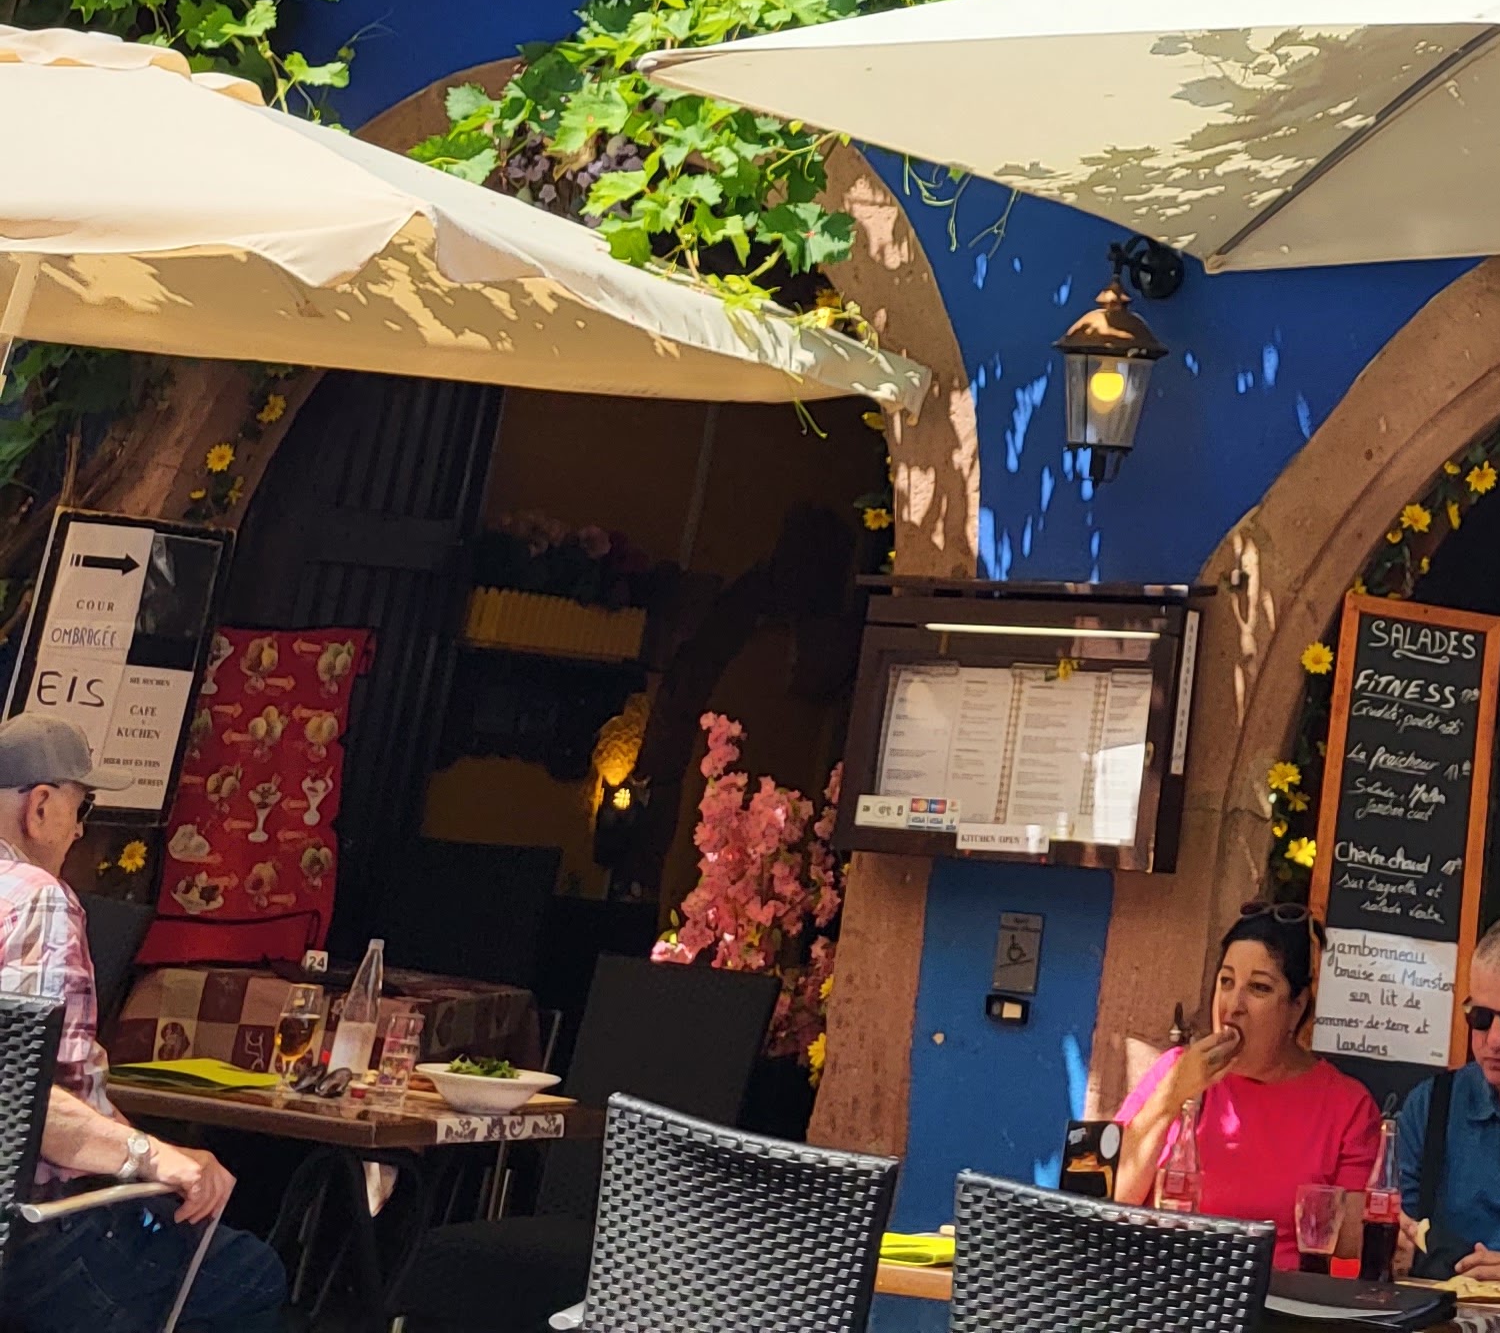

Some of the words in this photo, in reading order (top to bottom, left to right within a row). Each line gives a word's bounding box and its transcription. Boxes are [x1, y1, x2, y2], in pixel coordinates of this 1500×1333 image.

[76, 599, 115, 612] COUR
[51, 625, 117, 647] OMBRAGÉE
[1368, 620, 1476, 659] SALADES
[37, 670, 105, 708] EIS
[129, 704, 157, 717] CAFE
[116, 726, 161, 740] KUCHEN
[309, 955, 325, 970] 24
[1378, 973, 1397, 984] au
[1380, 988, 1398, 1006] lit
[1403, 992, 1421, 1010] de
[1336, 1033, 1388, 1056] lardons
